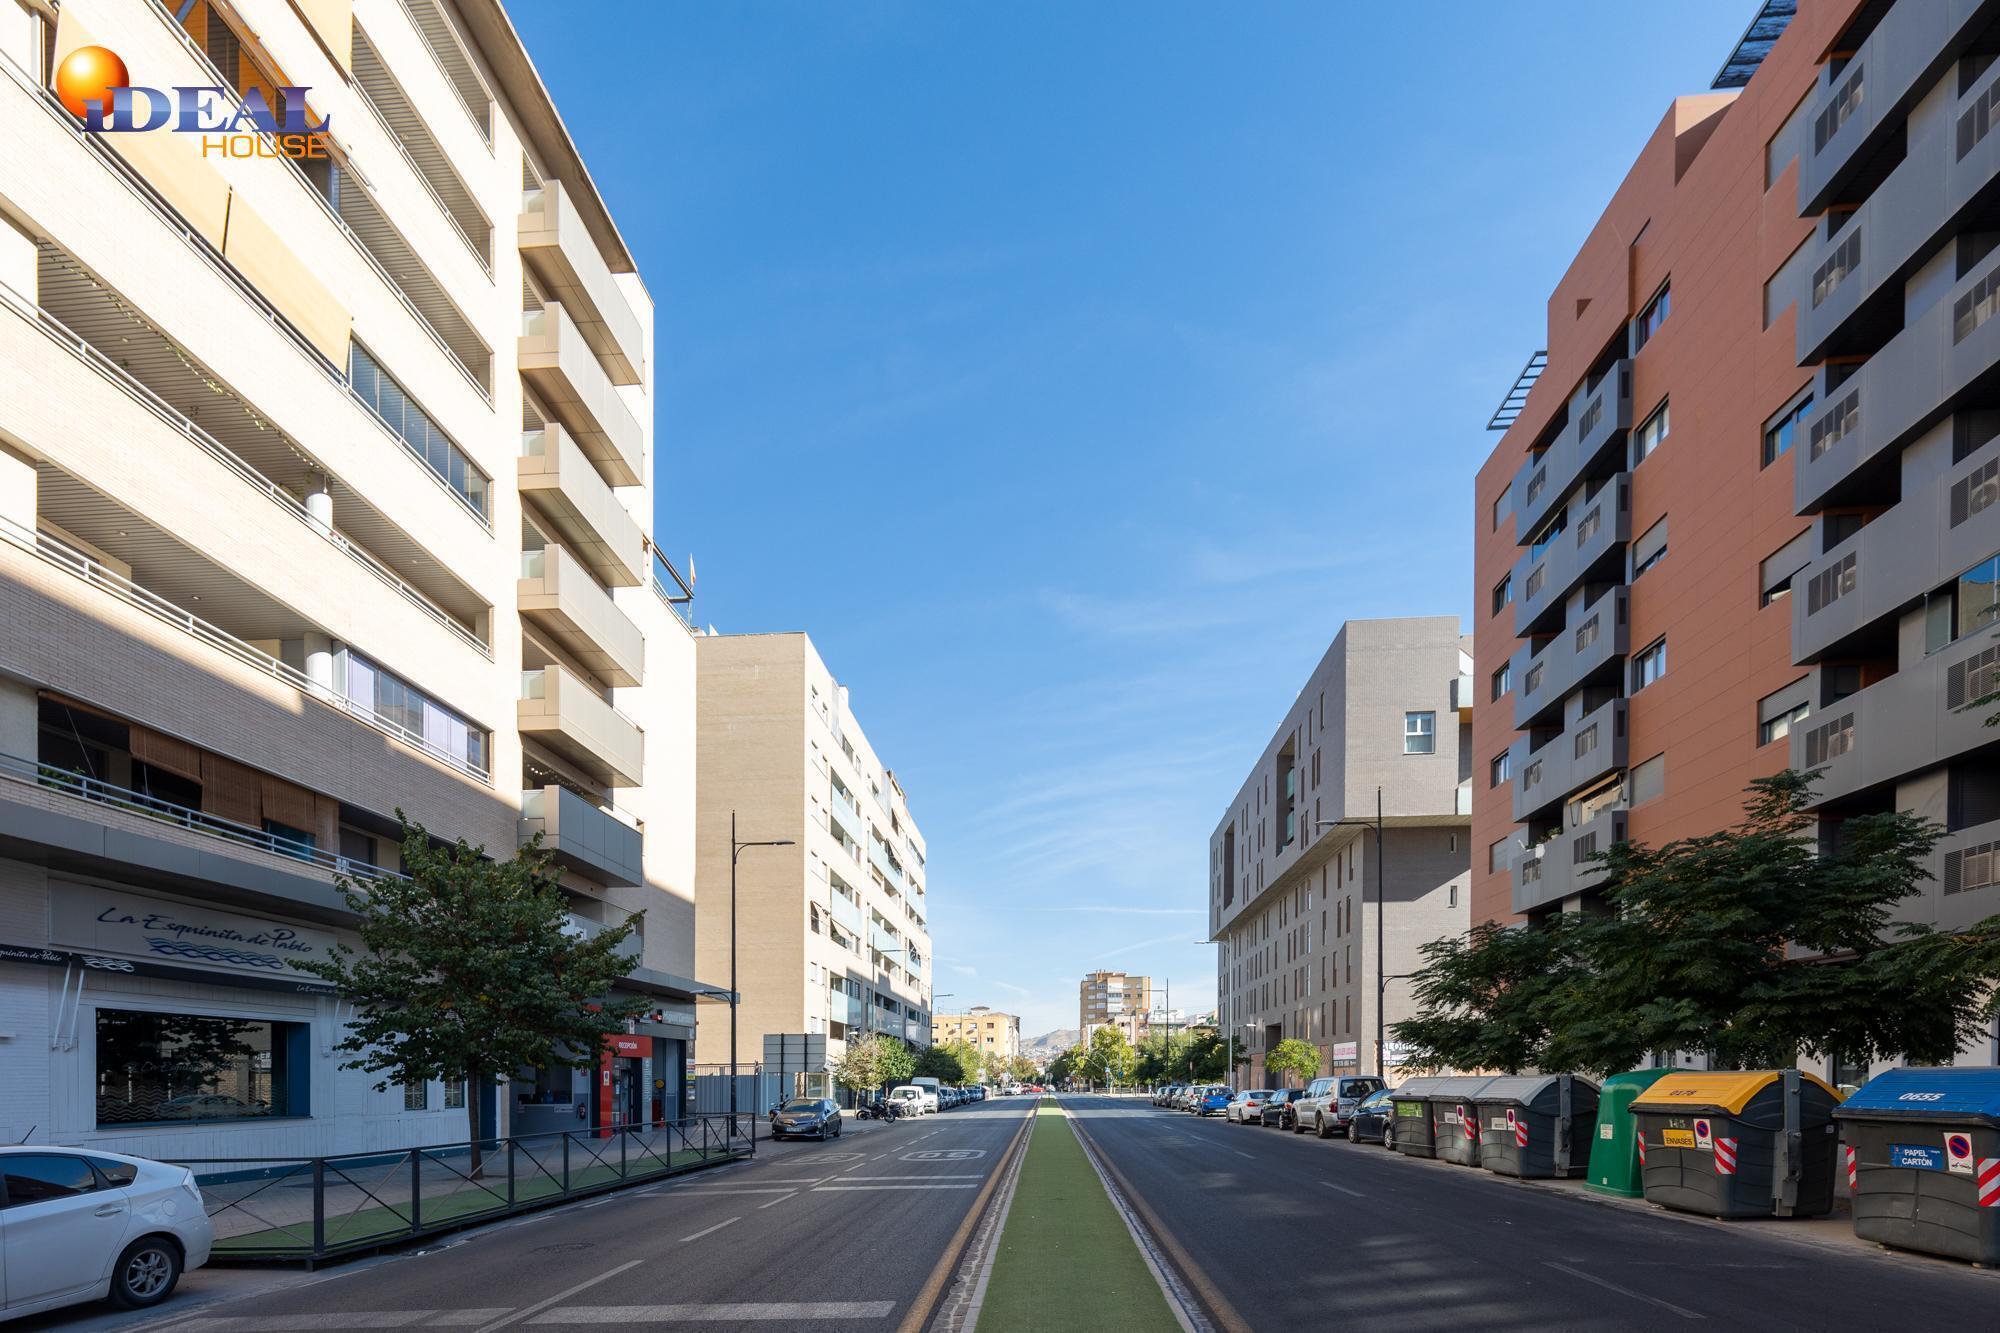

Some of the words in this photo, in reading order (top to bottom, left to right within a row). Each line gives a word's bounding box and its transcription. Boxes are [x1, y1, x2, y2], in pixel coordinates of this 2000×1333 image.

[97, 907, 139, 924] La
[142, 914, 243, 942] Esquinita
[246, 933, 268, 946] de
[265, 928, 313, 953] Pablo
[1898, 1092, 1946, 1101] 0655
[1666, 1137, 1693, 1146] ENVASES
[1904, 1149, 1929, 1157] PAPEL
[1902, 1157, 1933, 1167] CARTÓN
